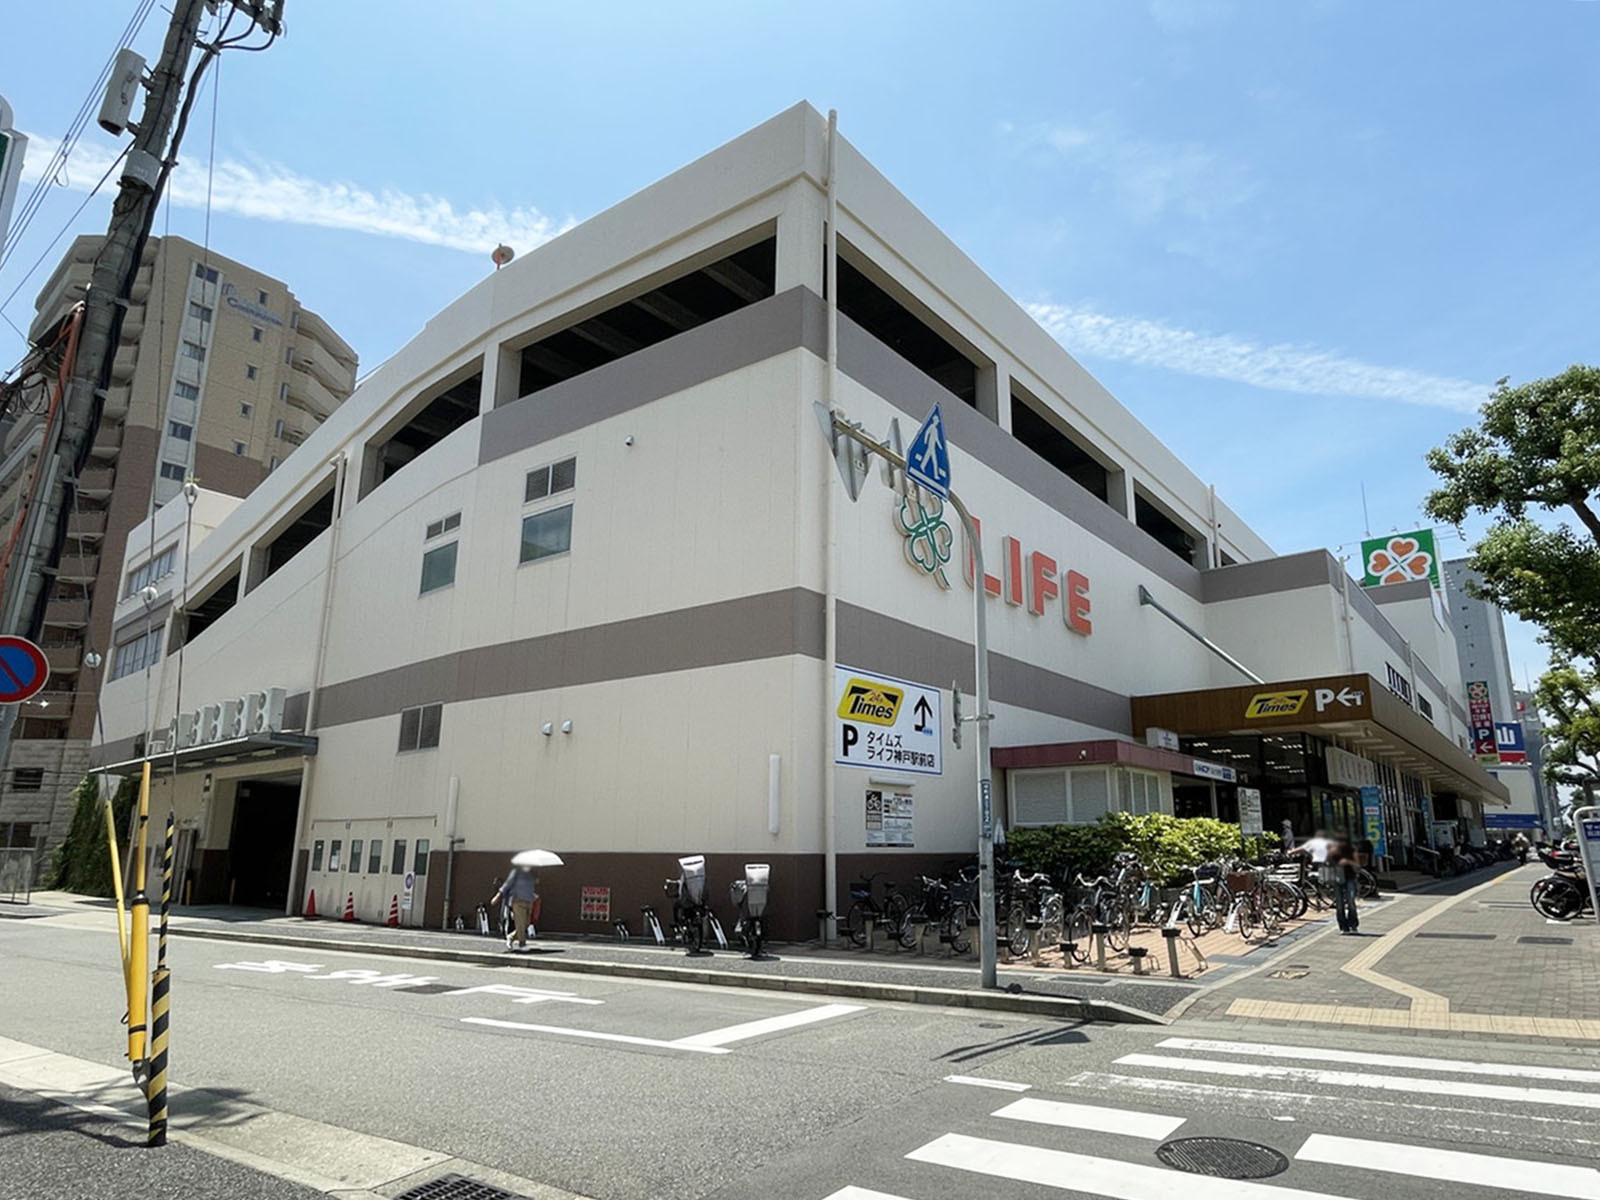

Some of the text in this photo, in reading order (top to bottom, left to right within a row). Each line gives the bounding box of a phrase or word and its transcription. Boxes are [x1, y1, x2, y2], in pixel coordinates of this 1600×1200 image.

[964, 515, 1092, 636] LIFE
[849, 686, 898, 719] Times
[1256, 696, 1301, 715] Times
[1315, 688, 1335, 712] P
[842, 723, 859, 757] P
[867, 731, 902, 748] タイムズ
[1478, 729, 1490, 740] P
[867, 746, 935, 768] ライフ神戸駅前店
[213, 959, 606, 1005] 止まれ
